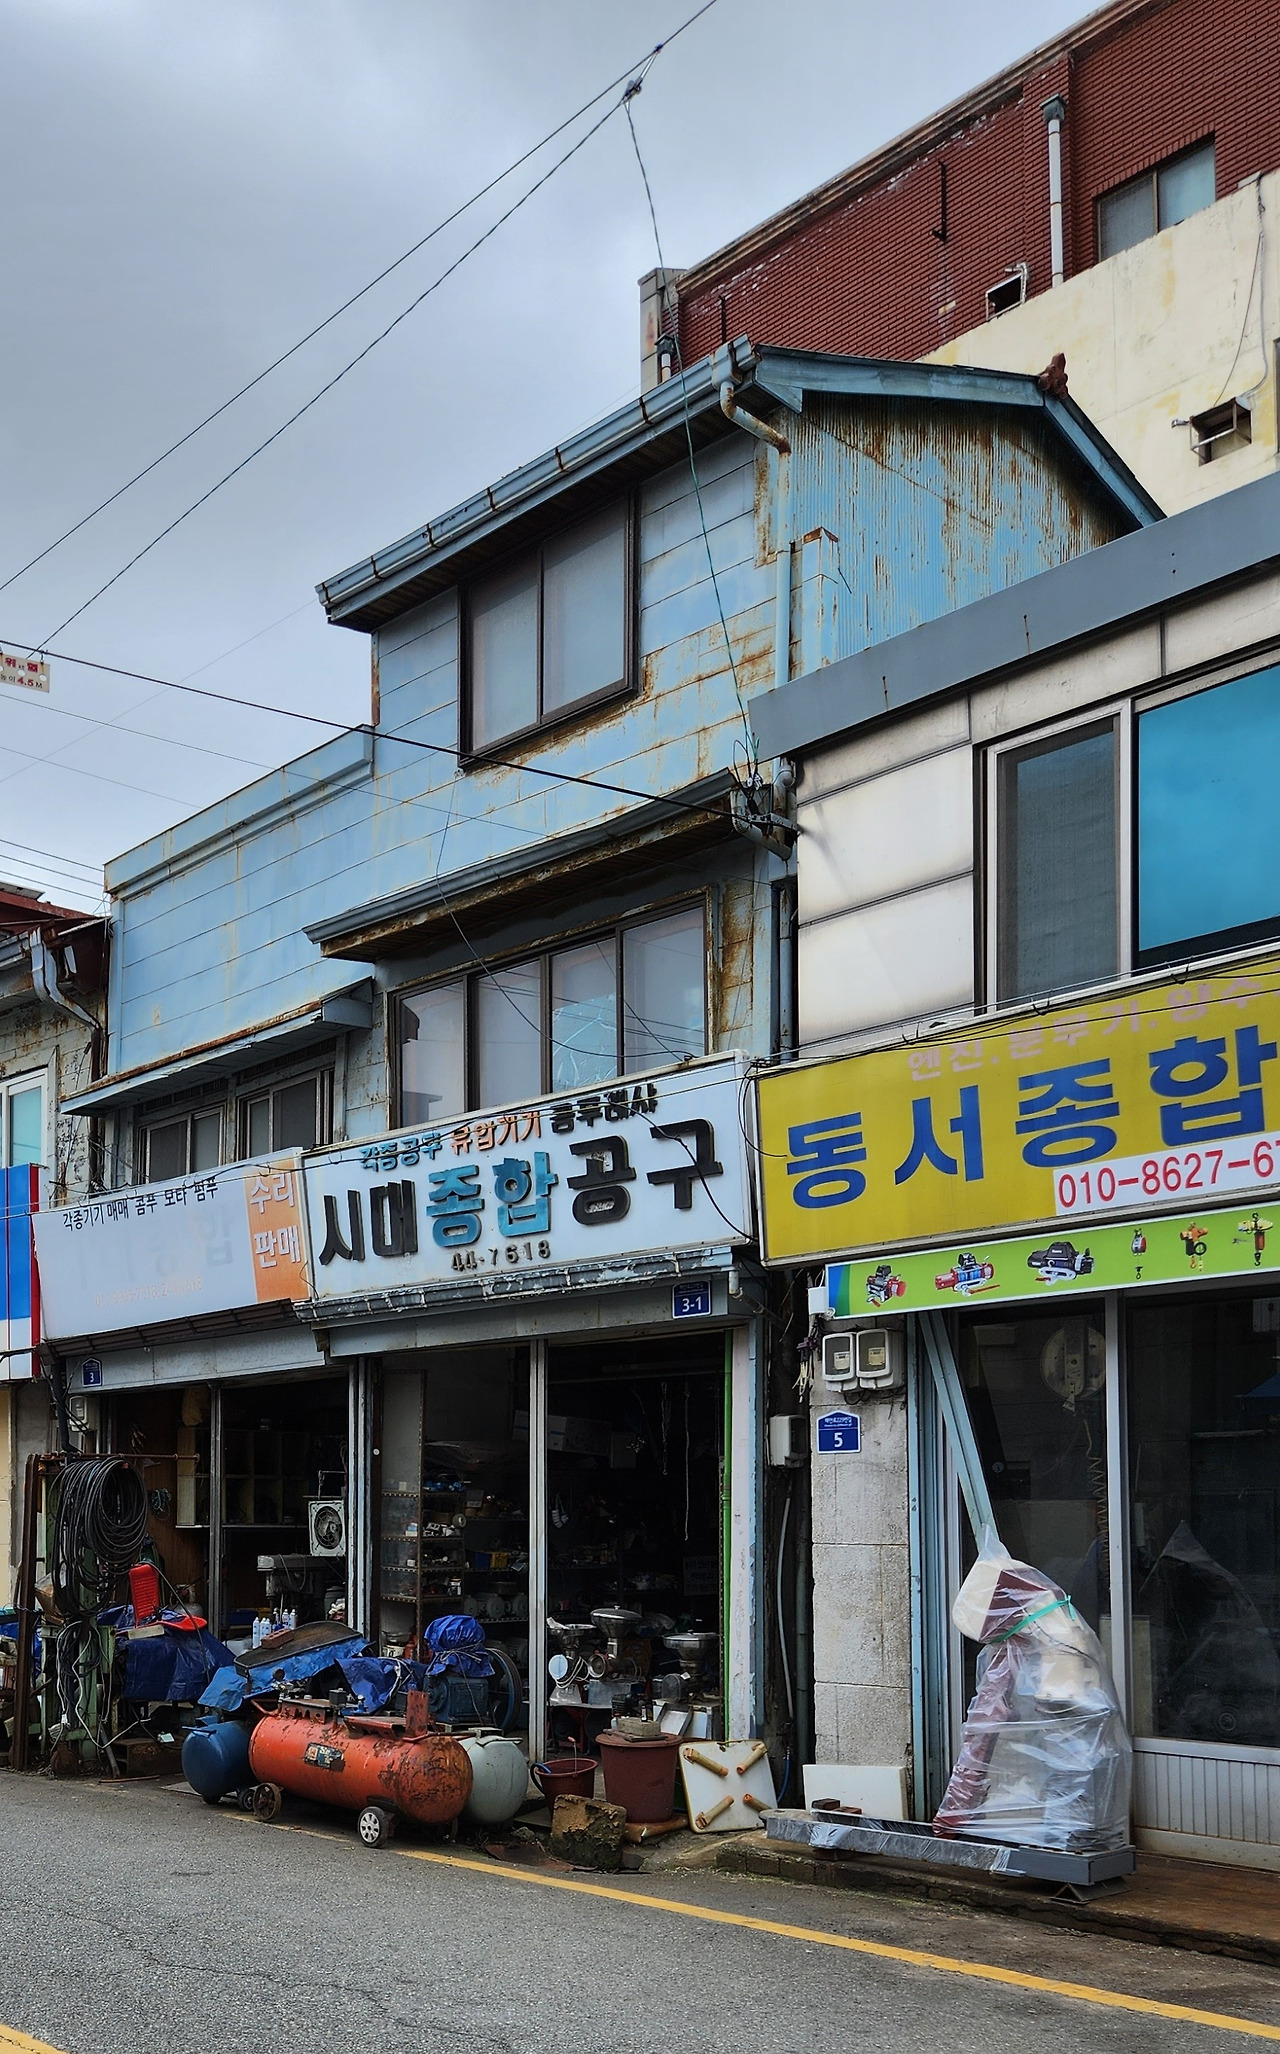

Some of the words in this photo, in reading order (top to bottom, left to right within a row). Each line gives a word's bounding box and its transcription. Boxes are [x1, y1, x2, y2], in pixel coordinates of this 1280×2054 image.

[450, 1111, 542, 1156] 유압기기
[250, 1171, 295, 1214] 수리
[1058, 1140, 1280, 1208] 010-8627-6
[62, 1206, 104, 1231] 각종기기
[106, 1199, 129, 1221] 매매
[135, 1195, 158, 1216] 콤푸
[254, 1224, 301, 1268] 판매
[682, 1296, 702, 1312] 3-1
[90, 1372, 95, 1383] 3
[834, 1432, 843, 1448] 5
